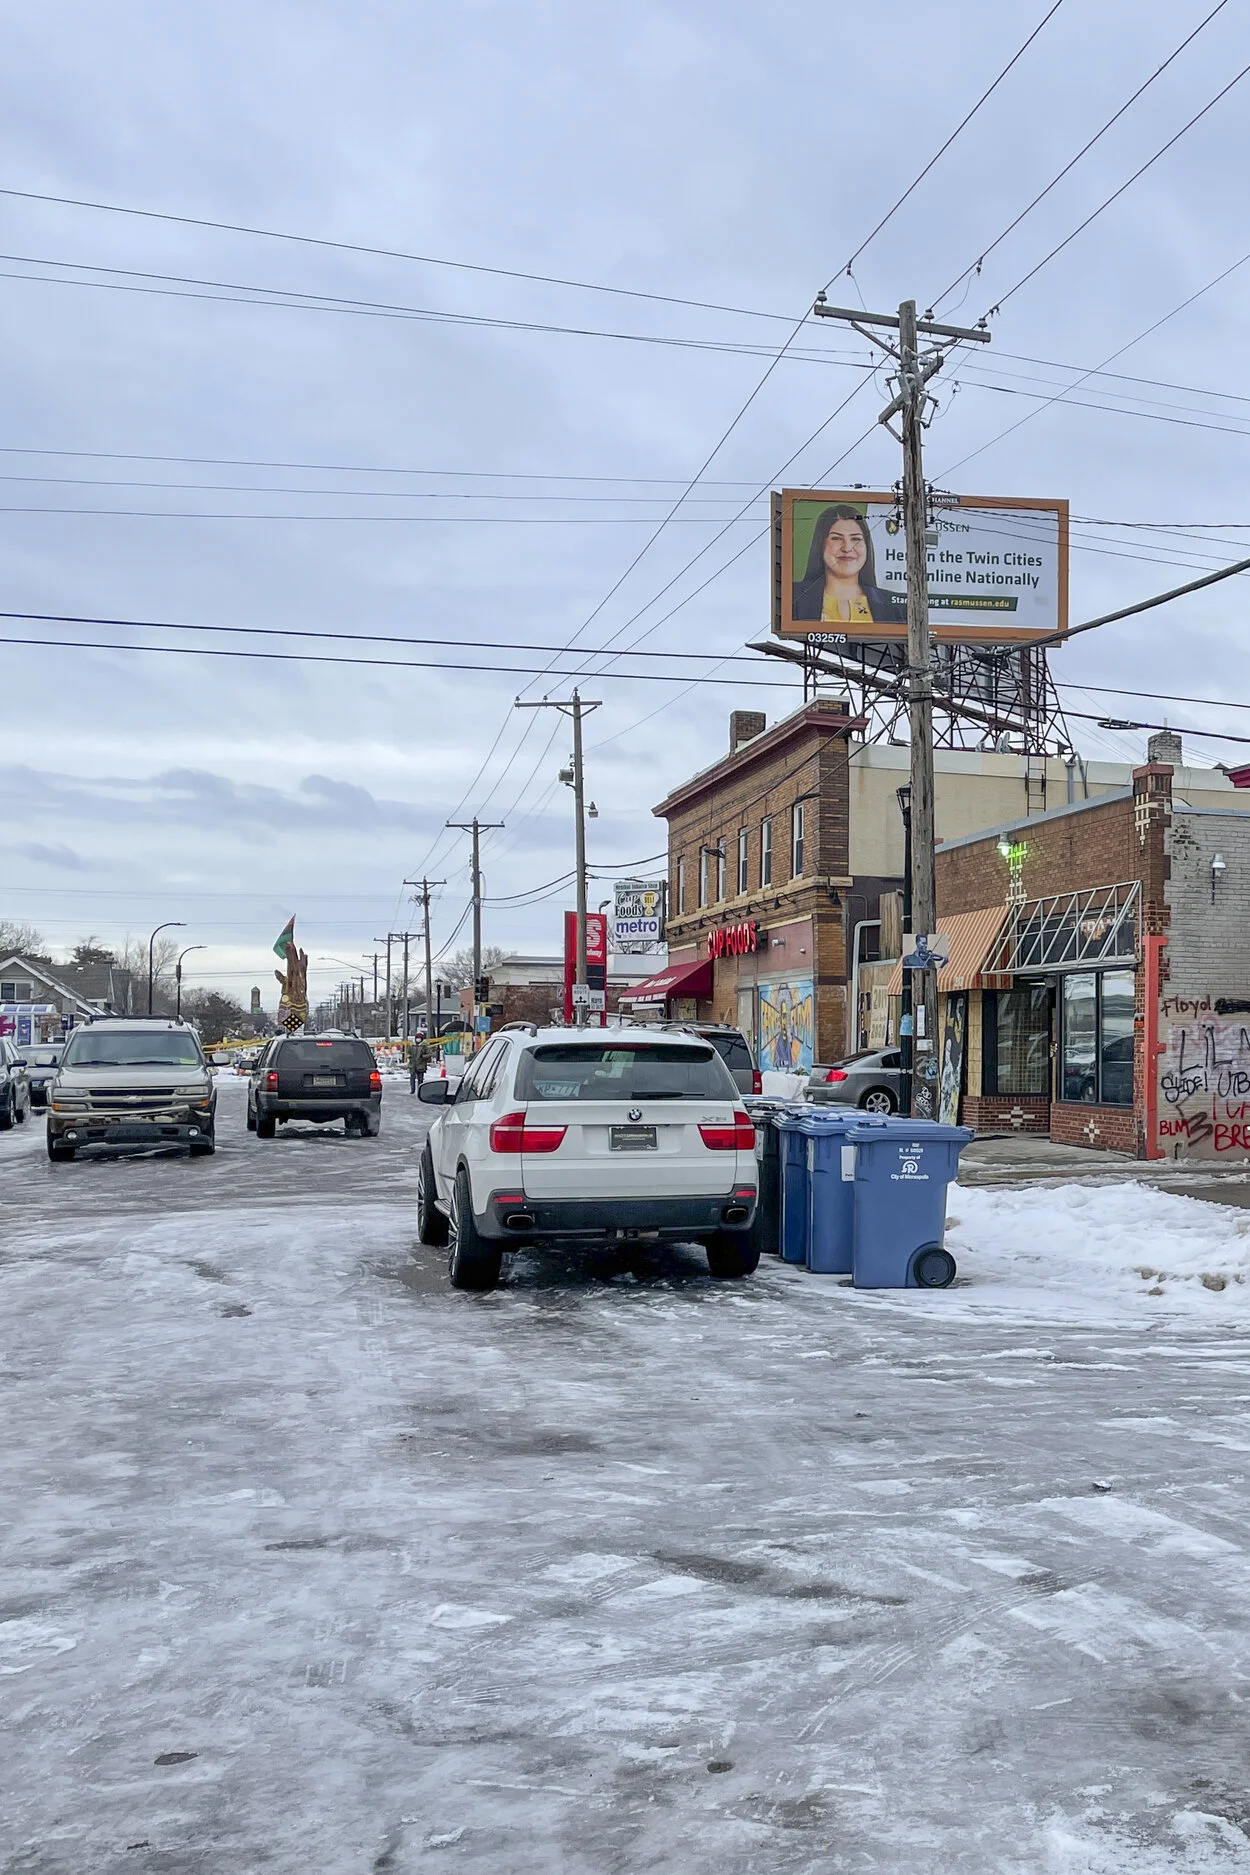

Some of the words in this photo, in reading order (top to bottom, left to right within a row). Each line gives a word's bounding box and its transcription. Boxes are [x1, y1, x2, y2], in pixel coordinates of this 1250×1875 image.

[935, 522, 970, 532] USSEN
[939, 550, 963, 564] the
[966, 552, 999, 565] Twin
[1003, 553, 1043, 567] Cities
[927, 569, 962, 583] nline
[966, 571, 1040, 589] Nationally
[950, 599, 1010, 608] rasmussen.edu
[807, 632, 847, 643] 032575
[615, 905, 642, 917] Foods
[616, 918, 658, 933] metro
[707, 929, 724, 959] CUP
[725, 919, 758, 957] FOODS
[1160, 994, 1213, 1019] Floyd
[1160, 1120, 1191, 1138] BLM
